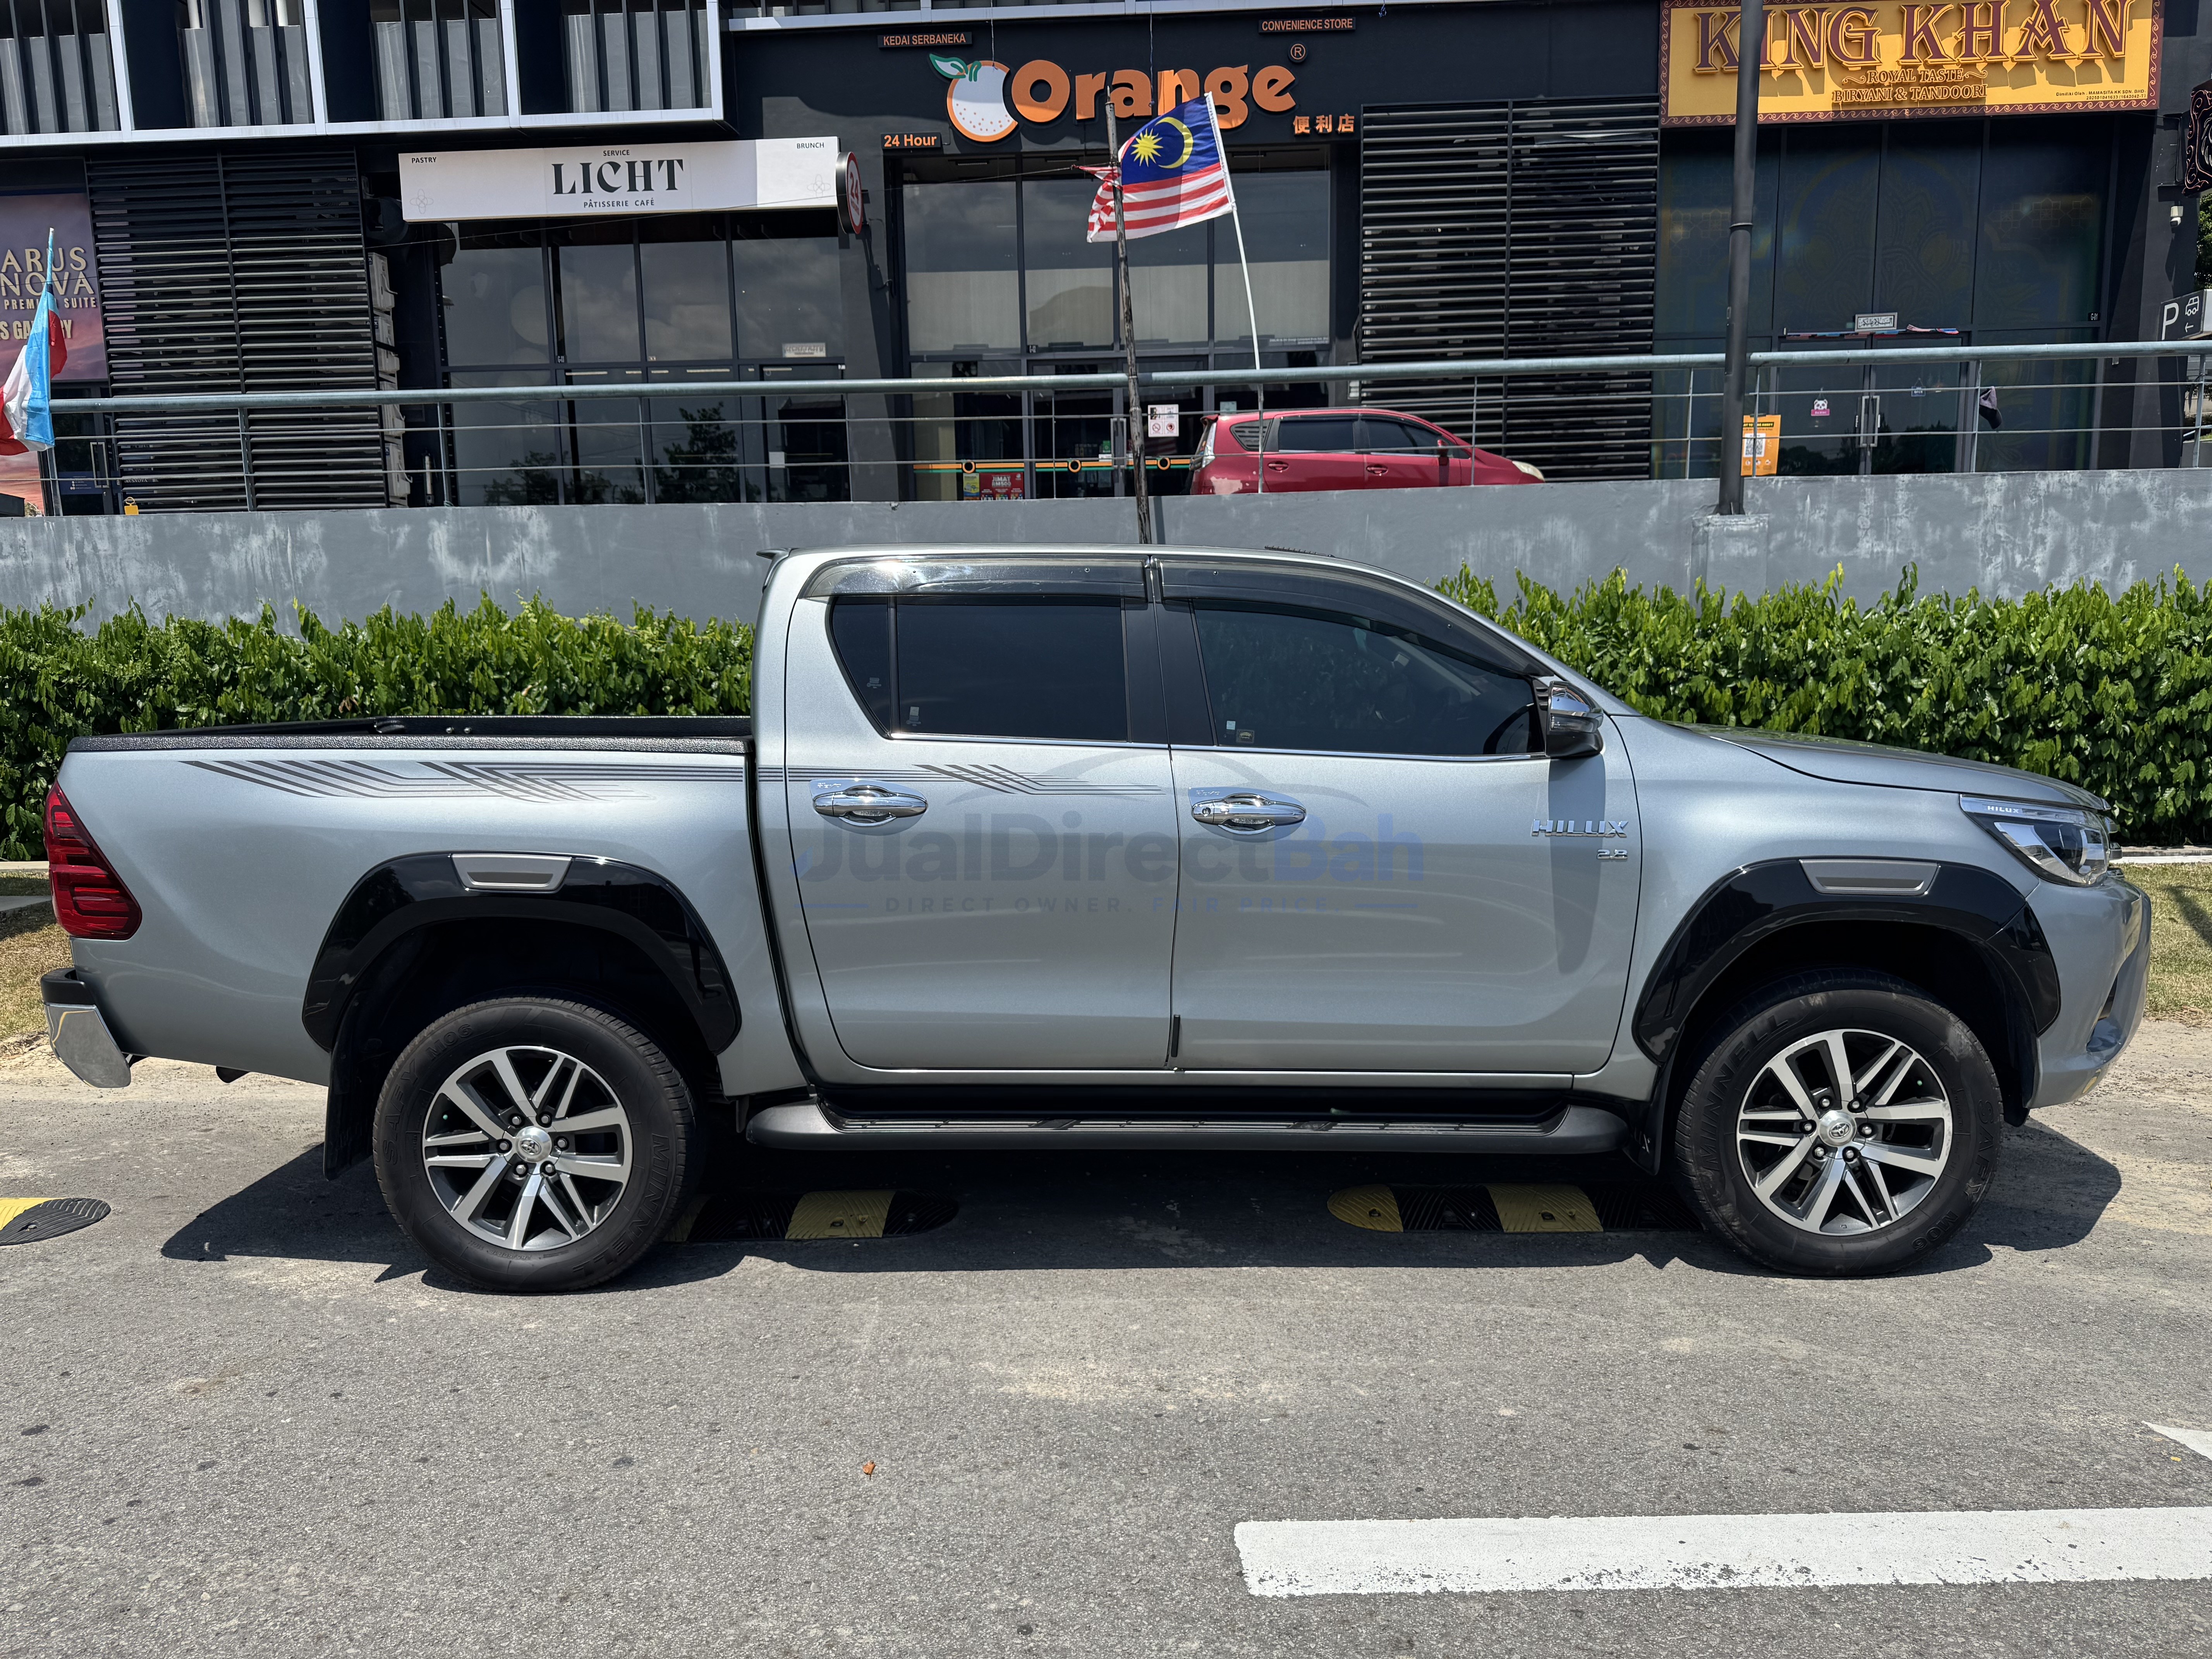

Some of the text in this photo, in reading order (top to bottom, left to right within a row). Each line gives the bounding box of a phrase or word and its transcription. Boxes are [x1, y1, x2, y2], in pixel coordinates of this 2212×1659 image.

[1262, 19, 1353, 31] CONVENIENCE STORE
[883, 33, 966, 46] KEDAI SERBANEKA
[1694, 0, 2135, 74] KING KHAN
[1867, 68, 1965, 84] ROYAL TASTE
[1011, 59, 1296, 129] Orange
[1833, 84, 1988, 103] BIRYANI & TANDOORI
[1293, 114, 1355, 134] 便利店
[884, 135, 937, 147] 24 Hour
[552, 159, 684, 194] LICHT
[850, 172, 859, 204] 24
[584, 198, 654, 208] PÂTISSERIE CAFÉ
[0, 271, 94, 296] NOVA
[64, 297, 96, 308] SUITE
[2162, 302, 2179, 340] P
[1987, 805, 2019, 814] HILUX
[1532, 819, 1628, 837] HILUX
[1597, 849, 1628, 860] 2.8
[1701, 1015, 1788, 1170] MINNELL
[383, 1058, 418, 1165] SAFY
[572, 1133, 670, 1277] MINNELL
